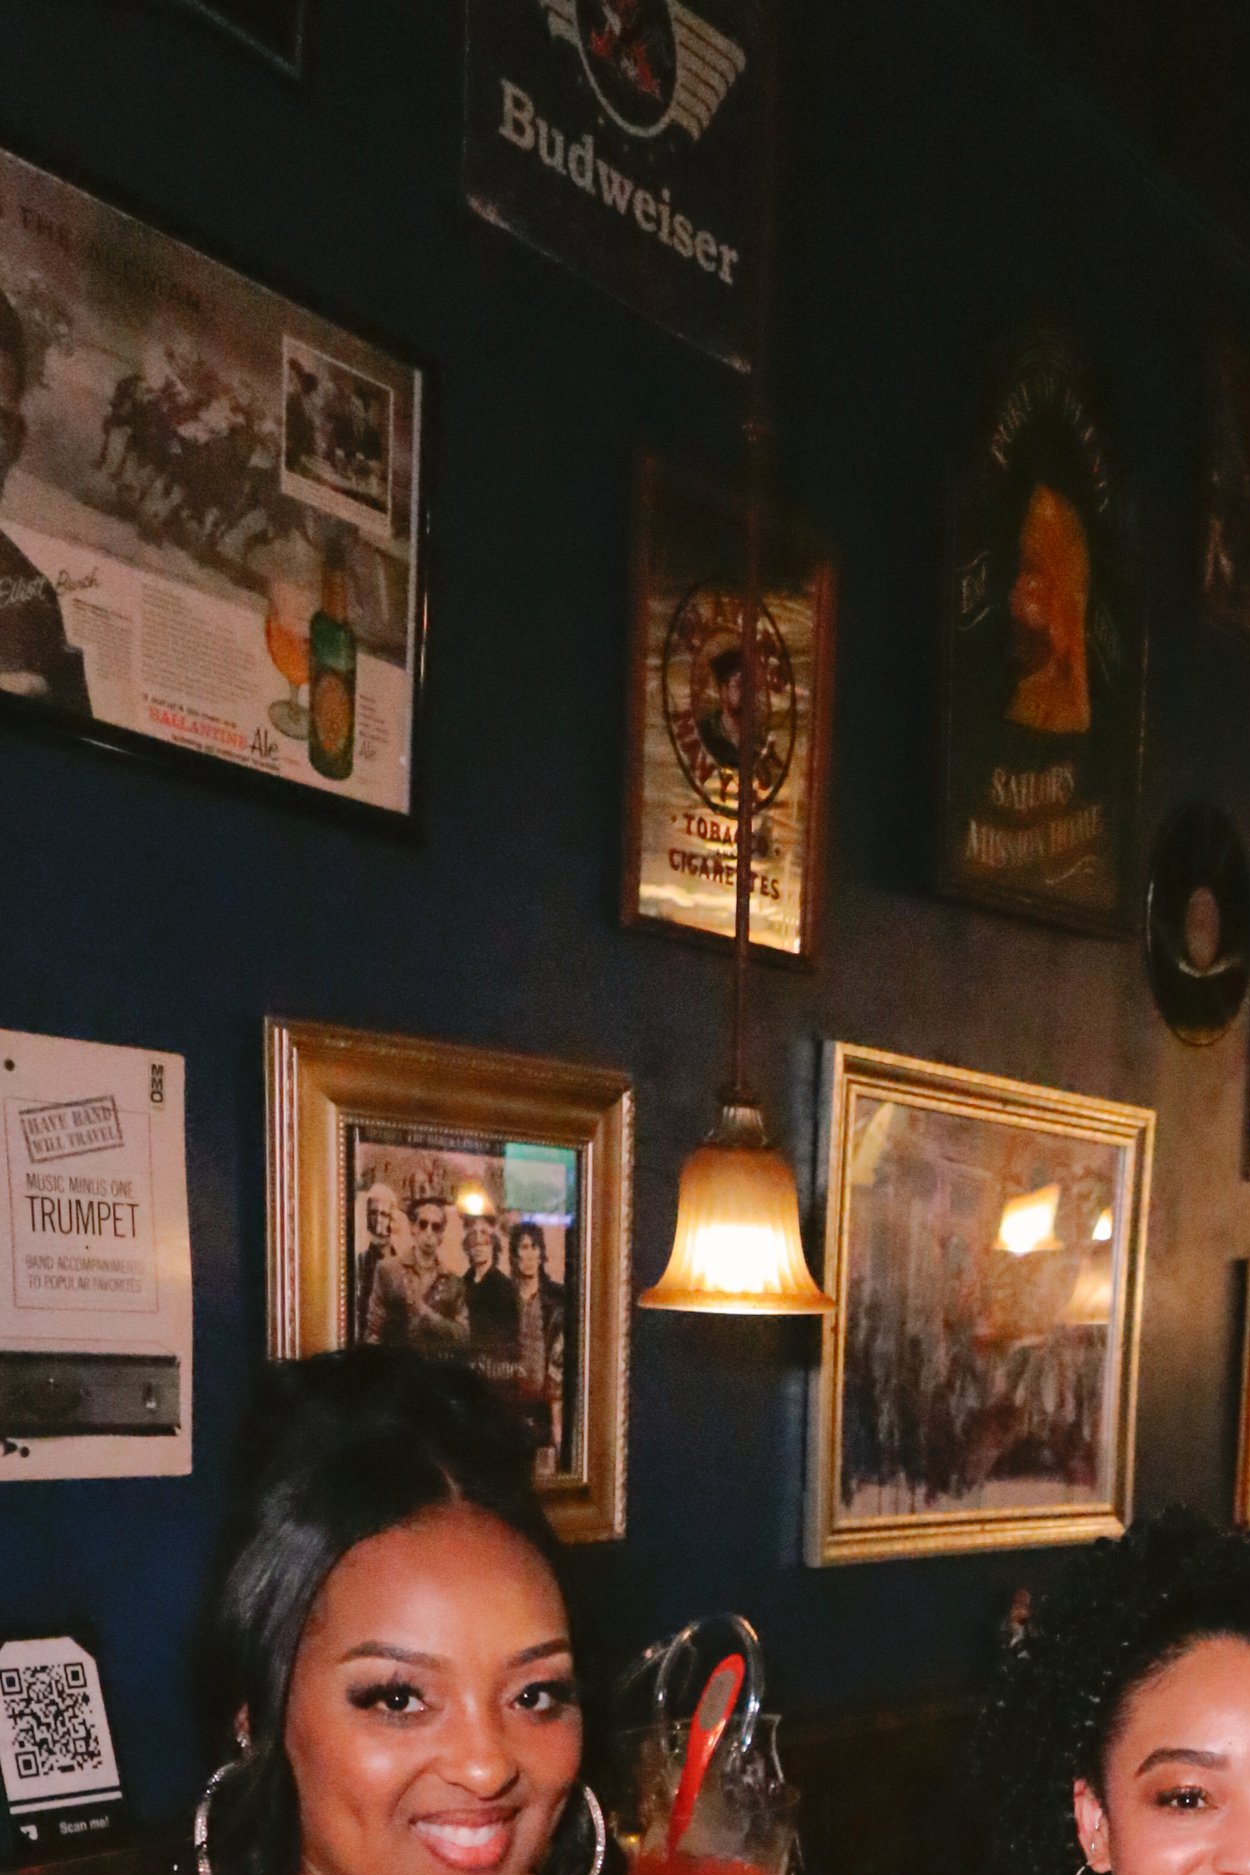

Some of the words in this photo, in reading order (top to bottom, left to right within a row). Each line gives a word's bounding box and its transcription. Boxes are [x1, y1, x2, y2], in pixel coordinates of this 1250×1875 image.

[498, 77, 740, 286] Budweiser
[250, 726, 279, 758] Ale
[668, 848, 780, 900] CIGARETES
[150, 1063, 164, 1104] MMO
[28, 1113, 67, 1135] HAVE
[71, 1105, 113, 1128] BAND
[32, 1136, 63, 1155] WILL
[69, 1125, 116, 1147] TRAVEL
[25, 1172, 65, 1194] MUSIC
[69, 1176, 107, 1197] MINUS
[111, 1179, 133, 1199] ONE
[25, 1195, 139, 1238] TRUMPET
[28, 1273, 42, 1289] TO
[44, 1275, 91, 1292] POPULAR
[93, 1277, 142, 1294] FAVORITES
[59, 1821, 88, 1835] Scan
[89, 1816, 110, 1830] me!
